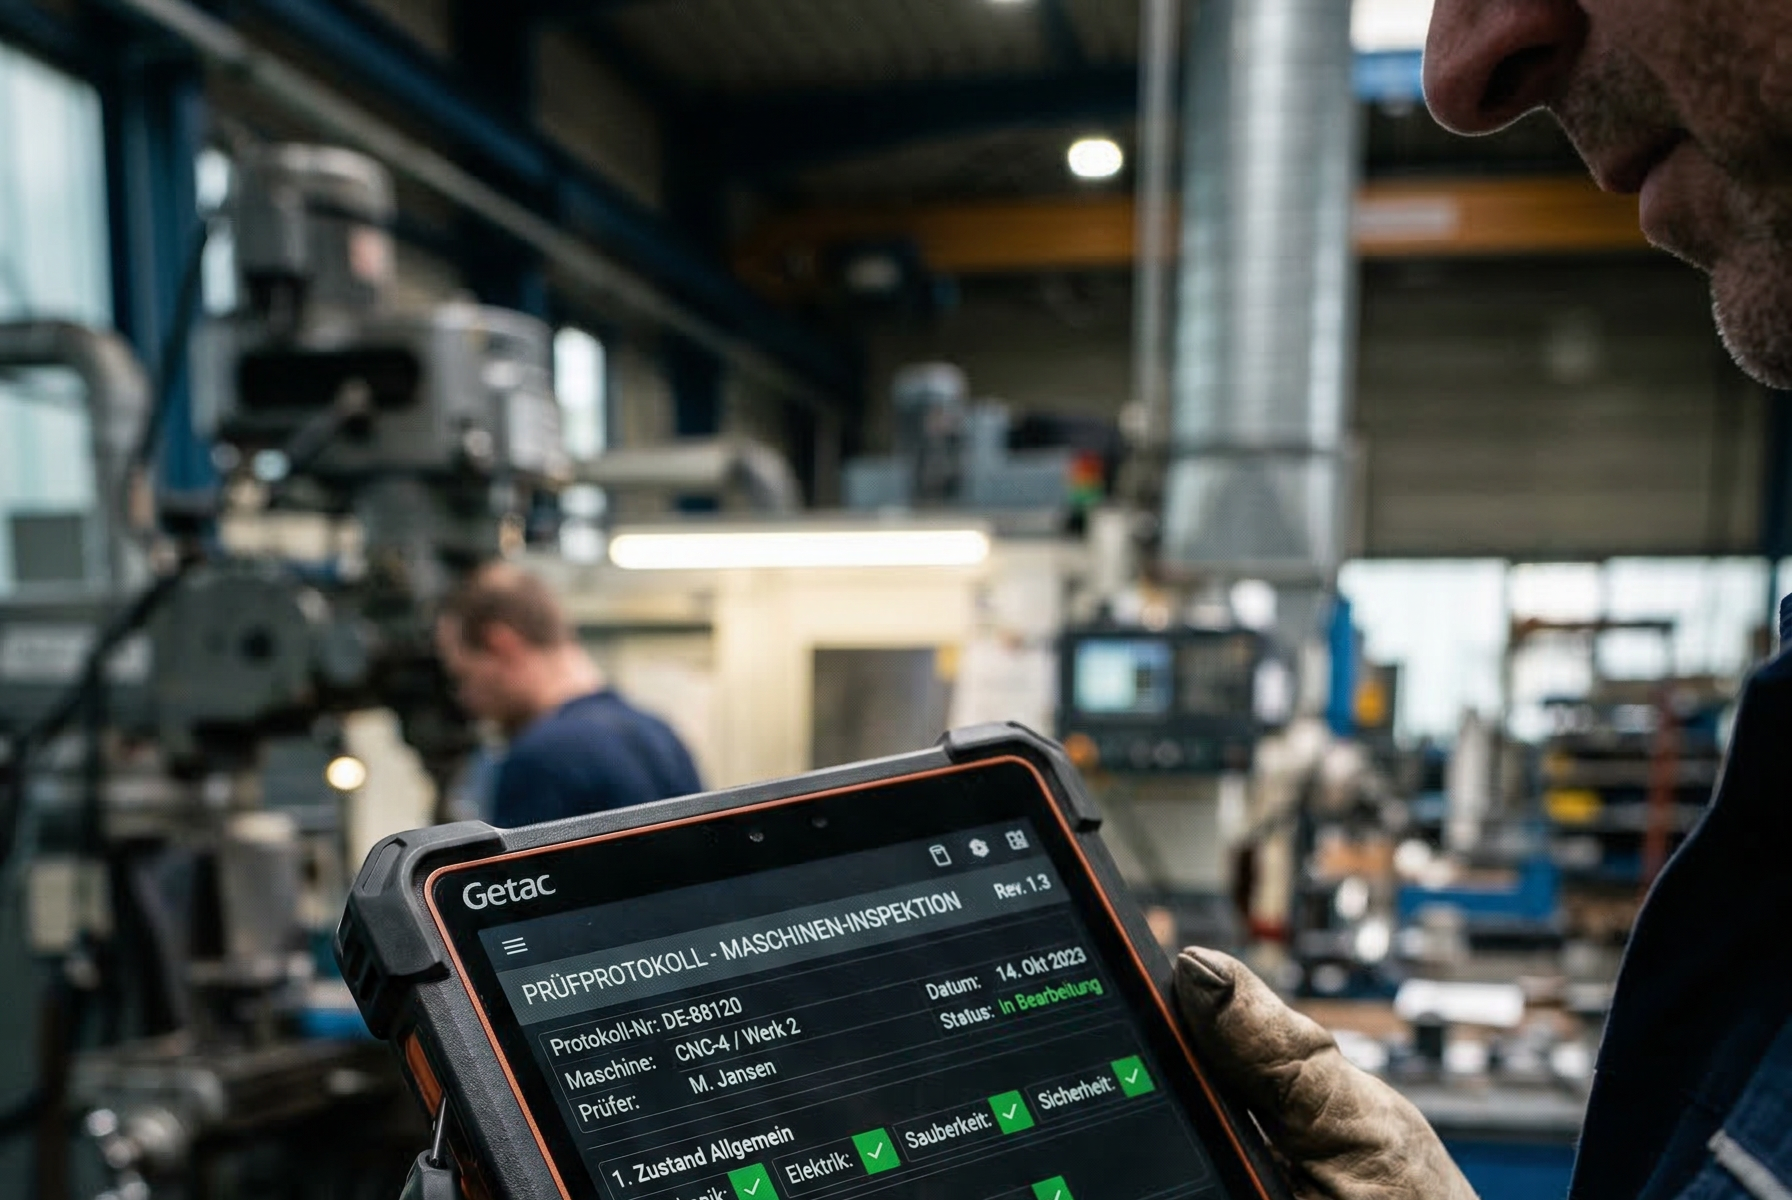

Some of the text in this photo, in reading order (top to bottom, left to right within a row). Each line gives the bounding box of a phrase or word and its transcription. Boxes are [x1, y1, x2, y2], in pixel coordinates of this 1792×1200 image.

[463, 874, 556, 910] Getac
[993, 873, 1052, 901] Rev. 1.3
[521, 947, 708, 1005] PRÜFPROTOKOLL
[720, 891, 962, 961] MASCHINEN-INSPEKTION
[925, 947, 1087, 1001] Datum: 14. Okt 2023
[998, 998, 1017, 1015] In
[1015, 977, 1103, 1011] Bearbeitung
[549, 996, 743, 1057] Protokoll-Nr: DE-88120
[564, 1054, 657, 1090] Maschine:
[674, 1034, 731, 1062] CNC-4
[741, 1021, 785, 1046] Werk
[786, 1017, 801, 1035] 2
[578, 1059, 777, 1122] Prüfer: M. Jansen
[1037, 1075, 1116, 1110] Sicherheit:
[612, 1126, 795, 1188] 1. Zustand Allgemein
[904, 1113, 993, 1149] Sauberkeit:
